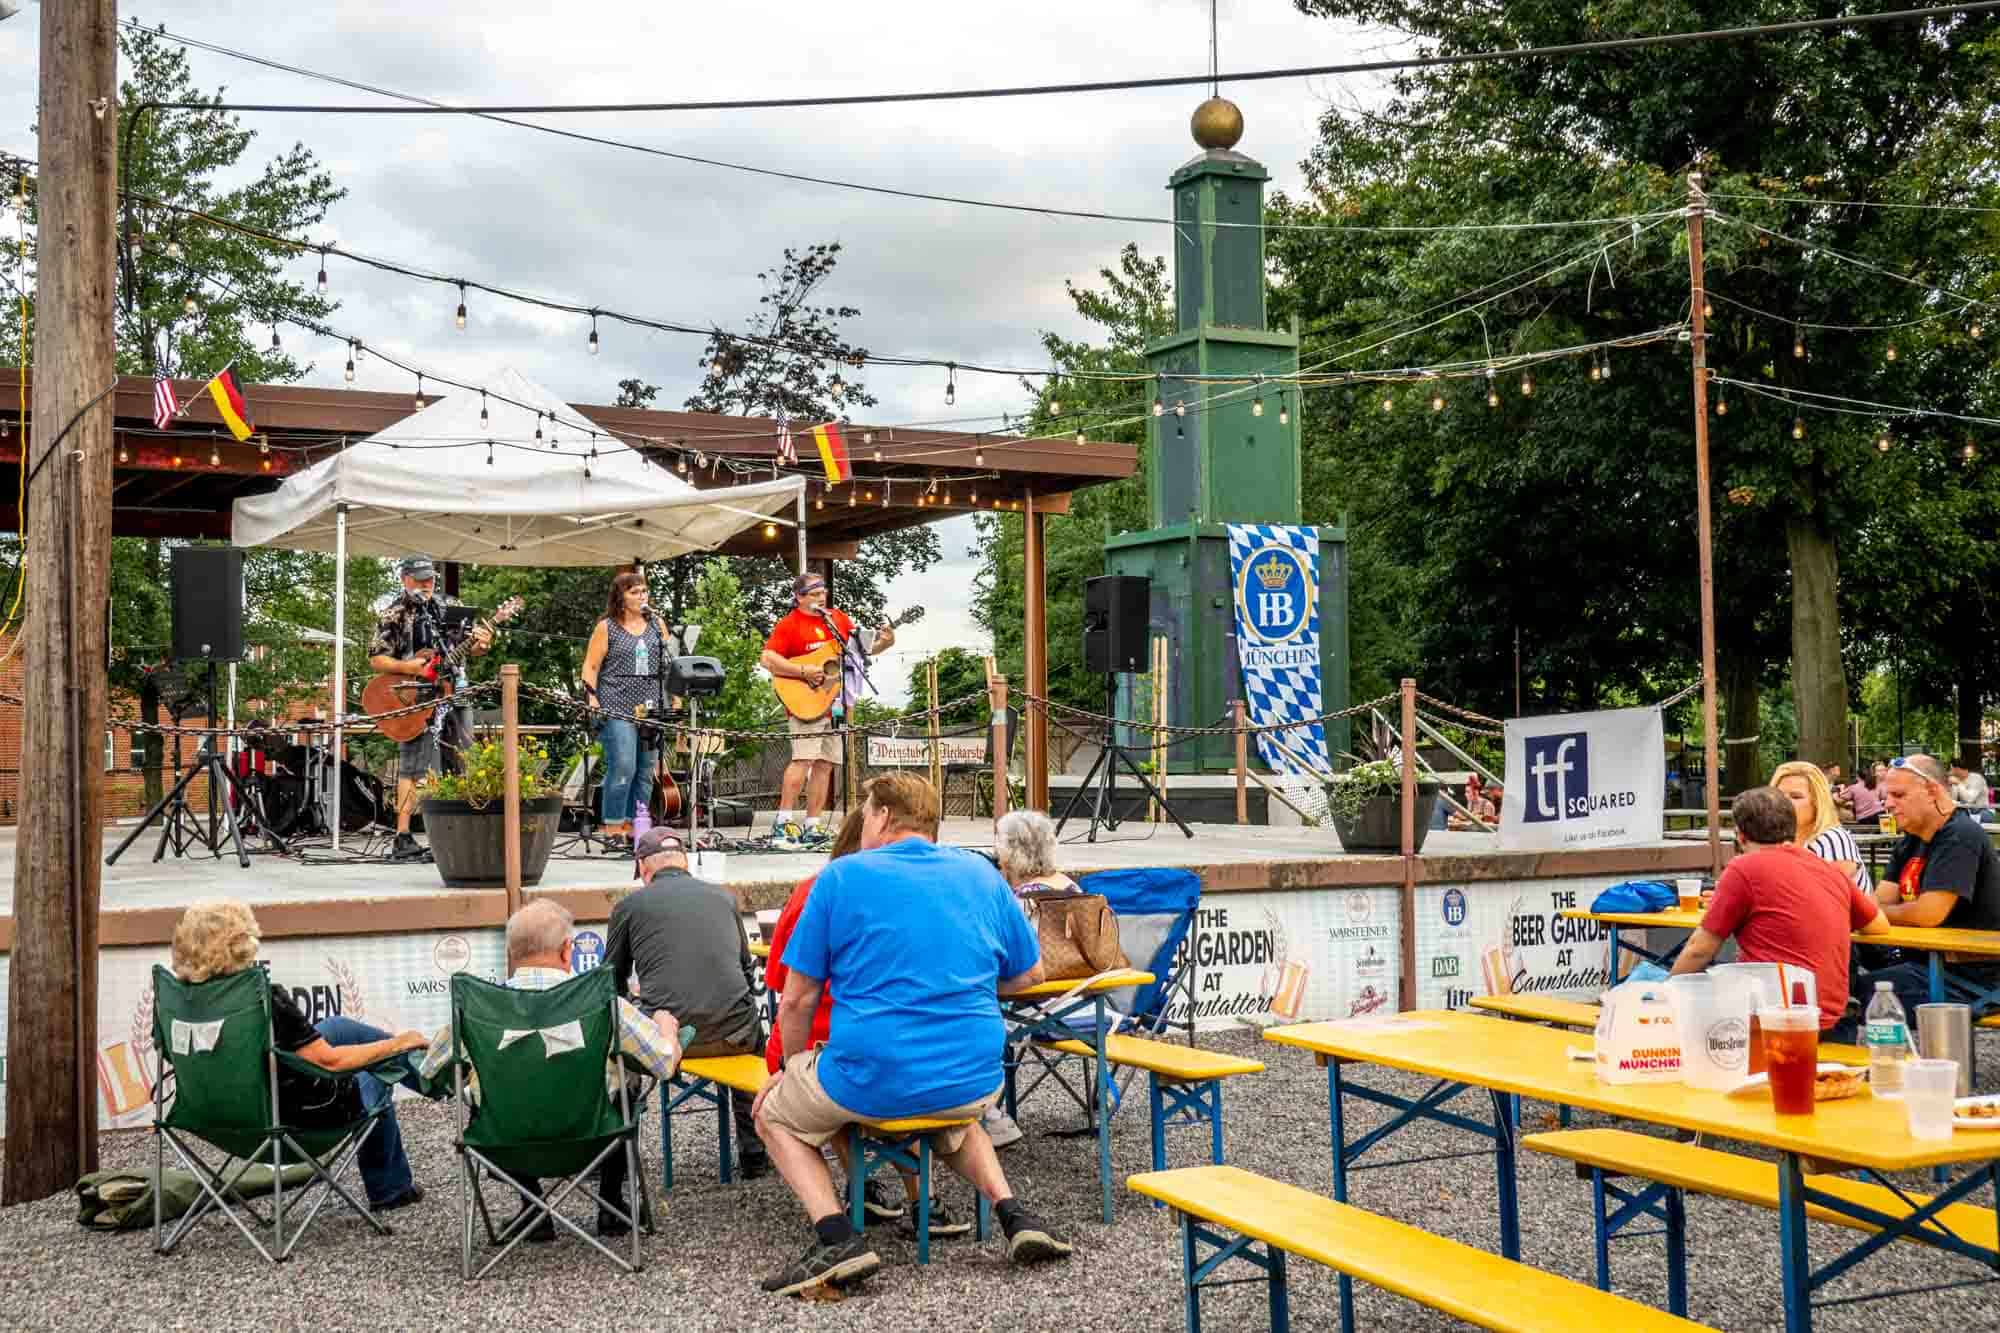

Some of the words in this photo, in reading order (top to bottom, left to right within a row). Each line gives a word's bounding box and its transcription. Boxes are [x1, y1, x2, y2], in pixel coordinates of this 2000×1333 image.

[1257, 593, 1295, 626] HB
[1531, 738, 1576, 821] tf
[1567, 791, 1636, 814] SQUARED
[1552, 891, 1576, 910] THE
[1197, 909, 1228, 929] THE
[1448, 906, 1462, 922] HB
[1328, 926, 1390, 938] WARSTEINER
[1513, 914, 1545, 947] BEER
[1197, 930, 1275, 967] GARDEN
[1556, 949, 1574, 967] AT
[1435, 959, 1457, 976] DAB
[1203, 972, 1223, 992] AT
[1510, 967, 1611, 994] Cannstatters
[1167, 991, 1275, 1020] annstatters
[1632, 1047, 1681, 1059] DUNKIN
